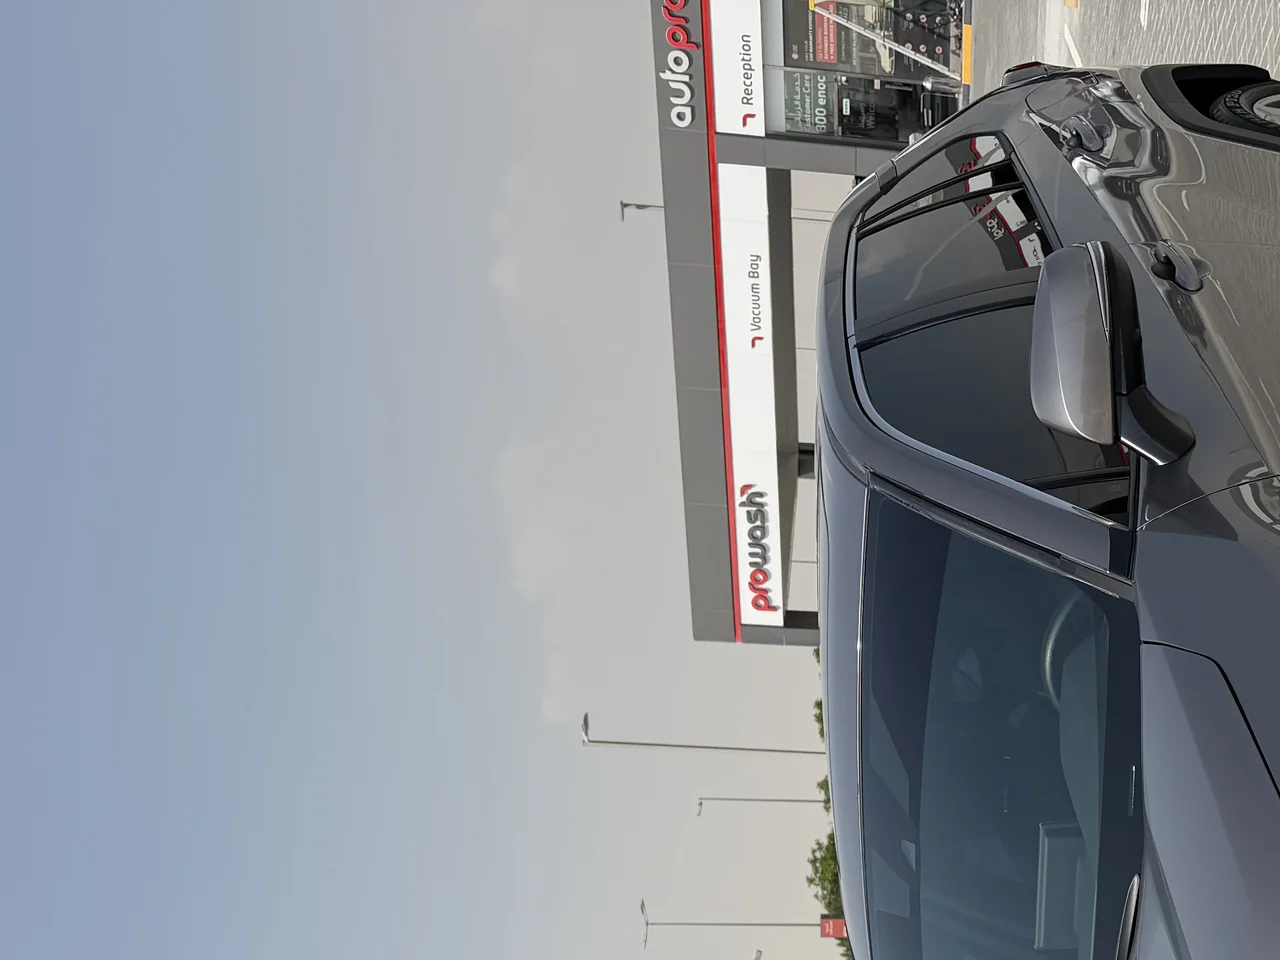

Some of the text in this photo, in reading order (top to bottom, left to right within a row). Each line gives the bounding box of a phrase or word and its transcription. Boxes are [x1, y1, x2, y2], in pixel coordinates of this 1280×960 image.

[739, 34, 755, 106] Reception
[802, 74, 810, 93] Care
[814, 75, 826, 132] 800 enoc
[748, 254, 762, 332] Vacuum Bay
[738, 491, 777, 612] prowash
